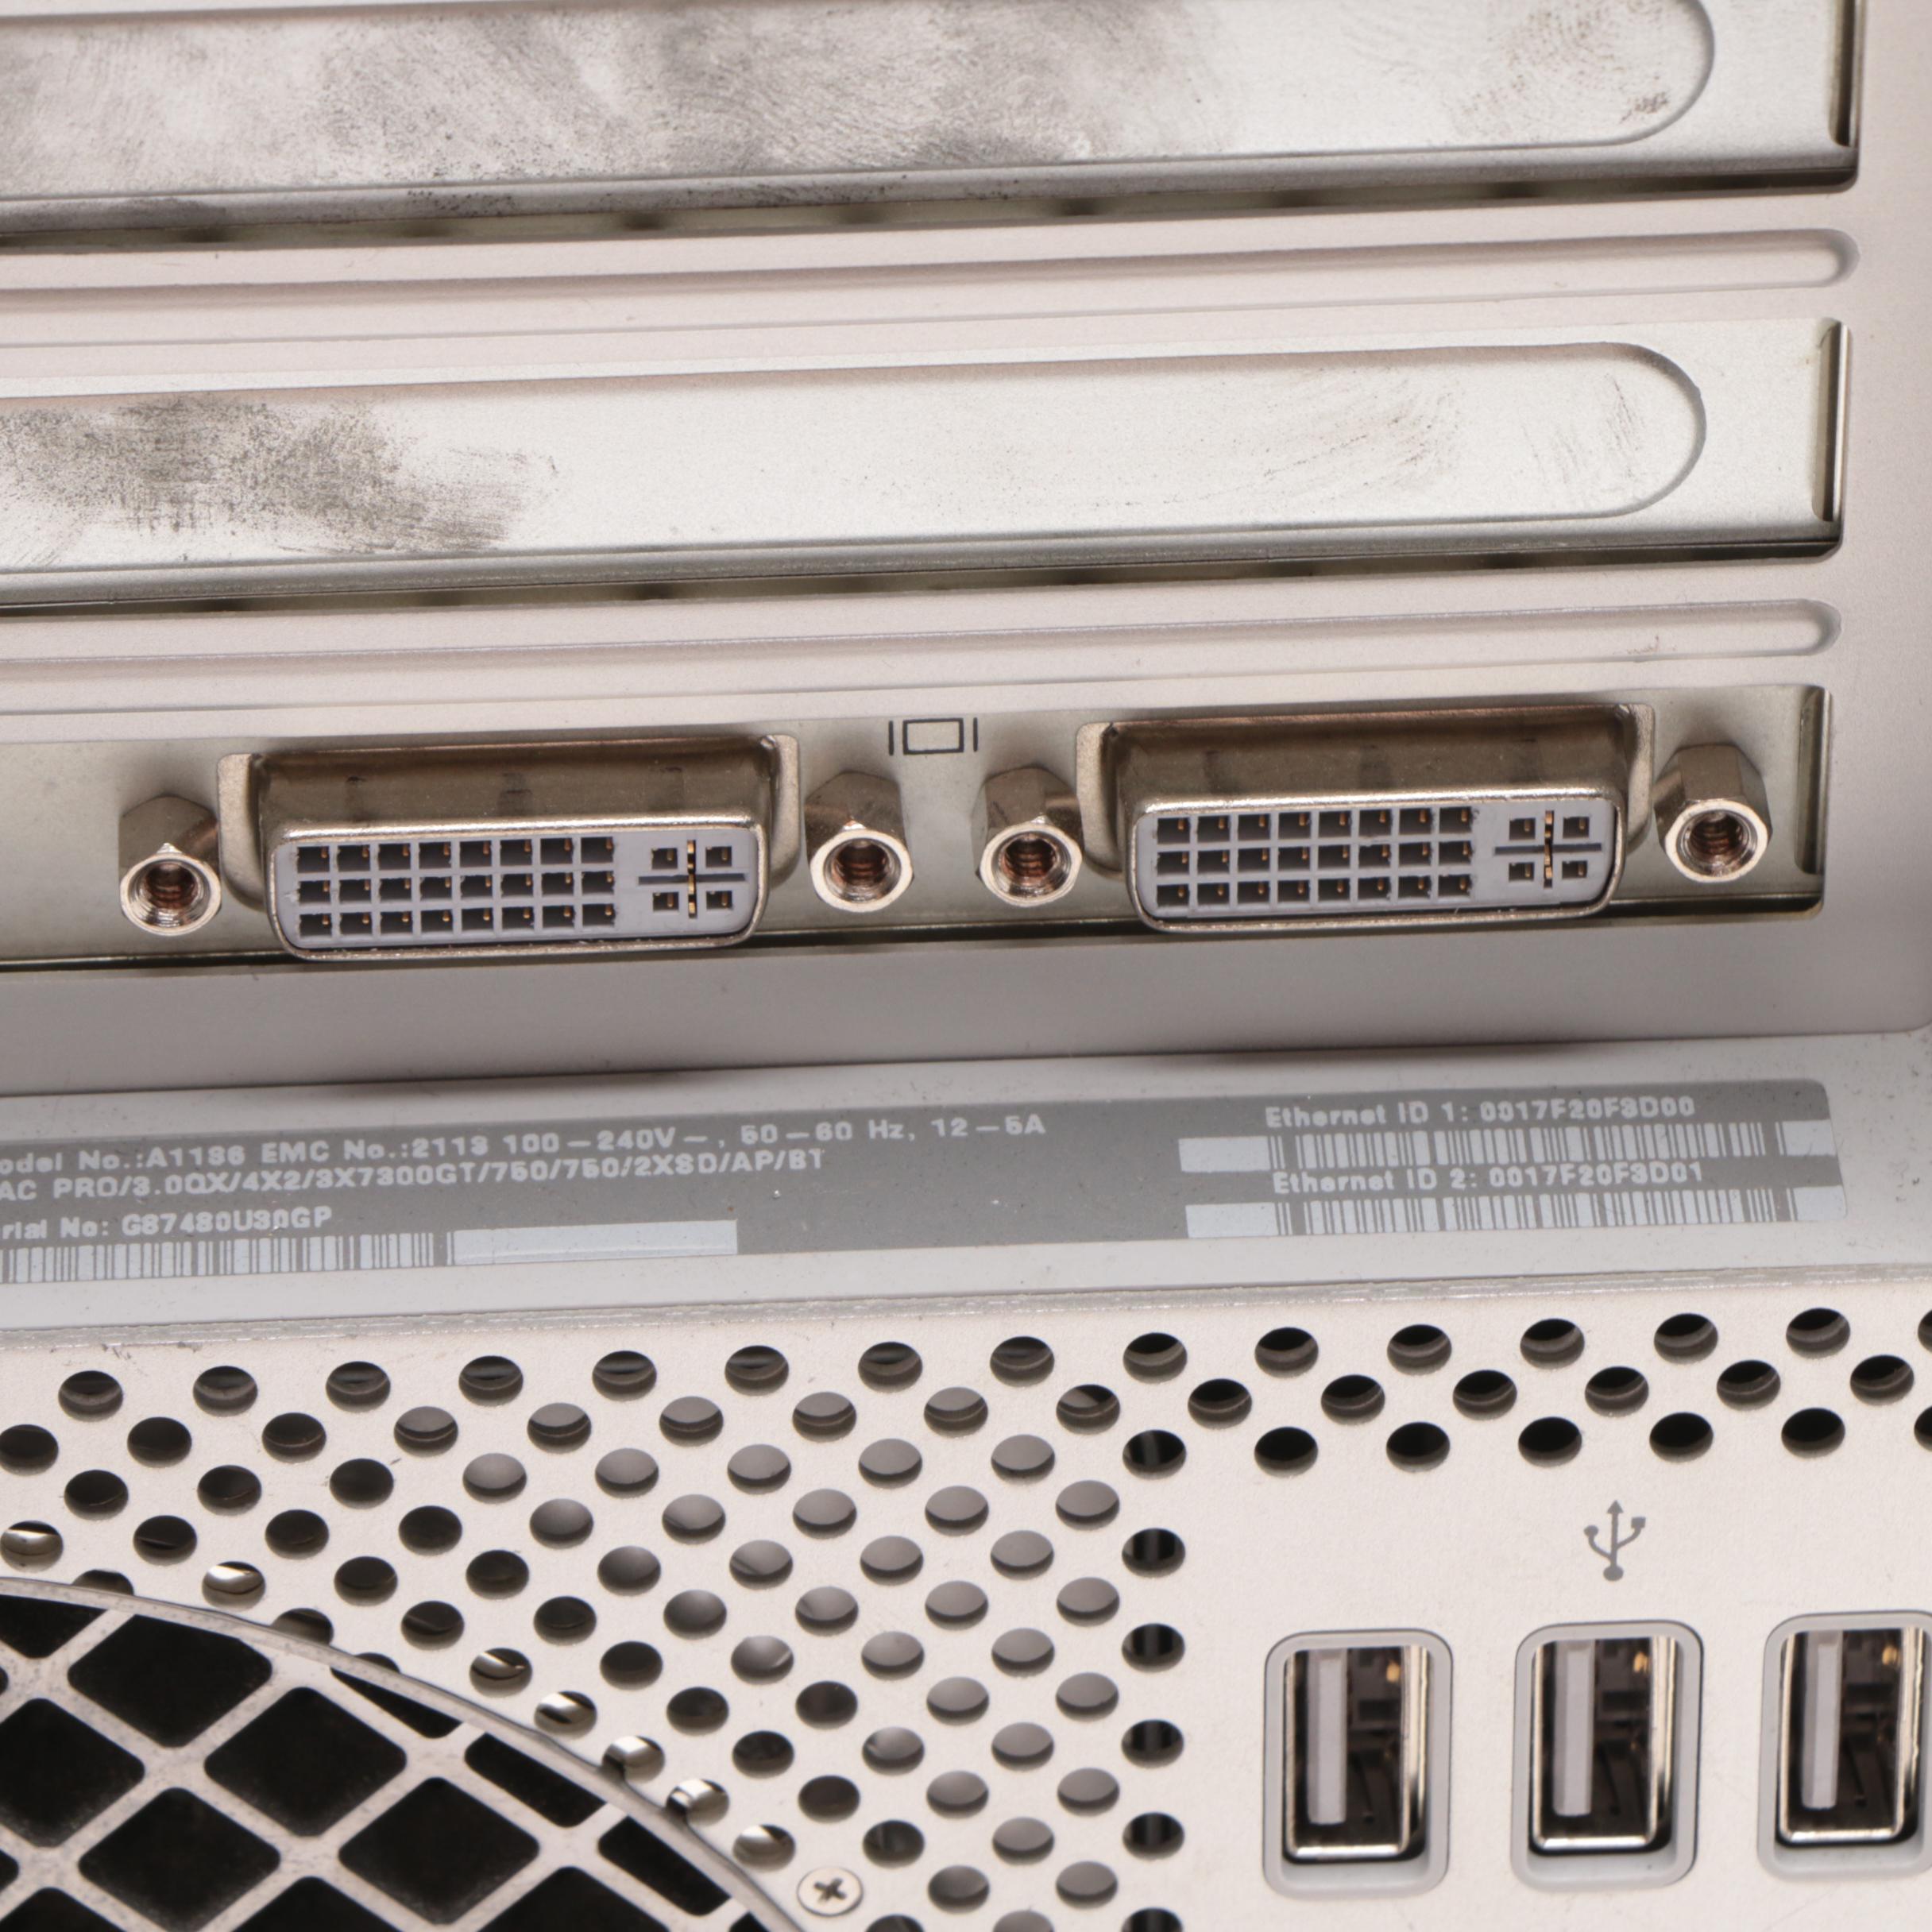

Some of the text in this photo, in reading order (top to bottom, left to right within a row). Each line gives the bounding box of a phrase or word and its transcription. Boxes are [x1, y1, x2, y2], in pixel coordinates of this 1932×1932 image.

[1265, 1104, 1387, 1129] Ethernet
[1398, 1100, 1429, 1124] ID
[1442, 1101, 1468, 1122] 1:
[261, 1140, 330, 1164] EMC
[868, 1119, 915, 1142] Hz,
[0, 1179, 37, 1201] AC
[1273, 1170, 1395, 1194] Ethernet
[1407, 1168, 1438, 1190] ID
[1450, 1168, 1478, 1190] 2:
[2, 1219, 47, 1240] rial
[60, 1216, 109, 1238] No:
